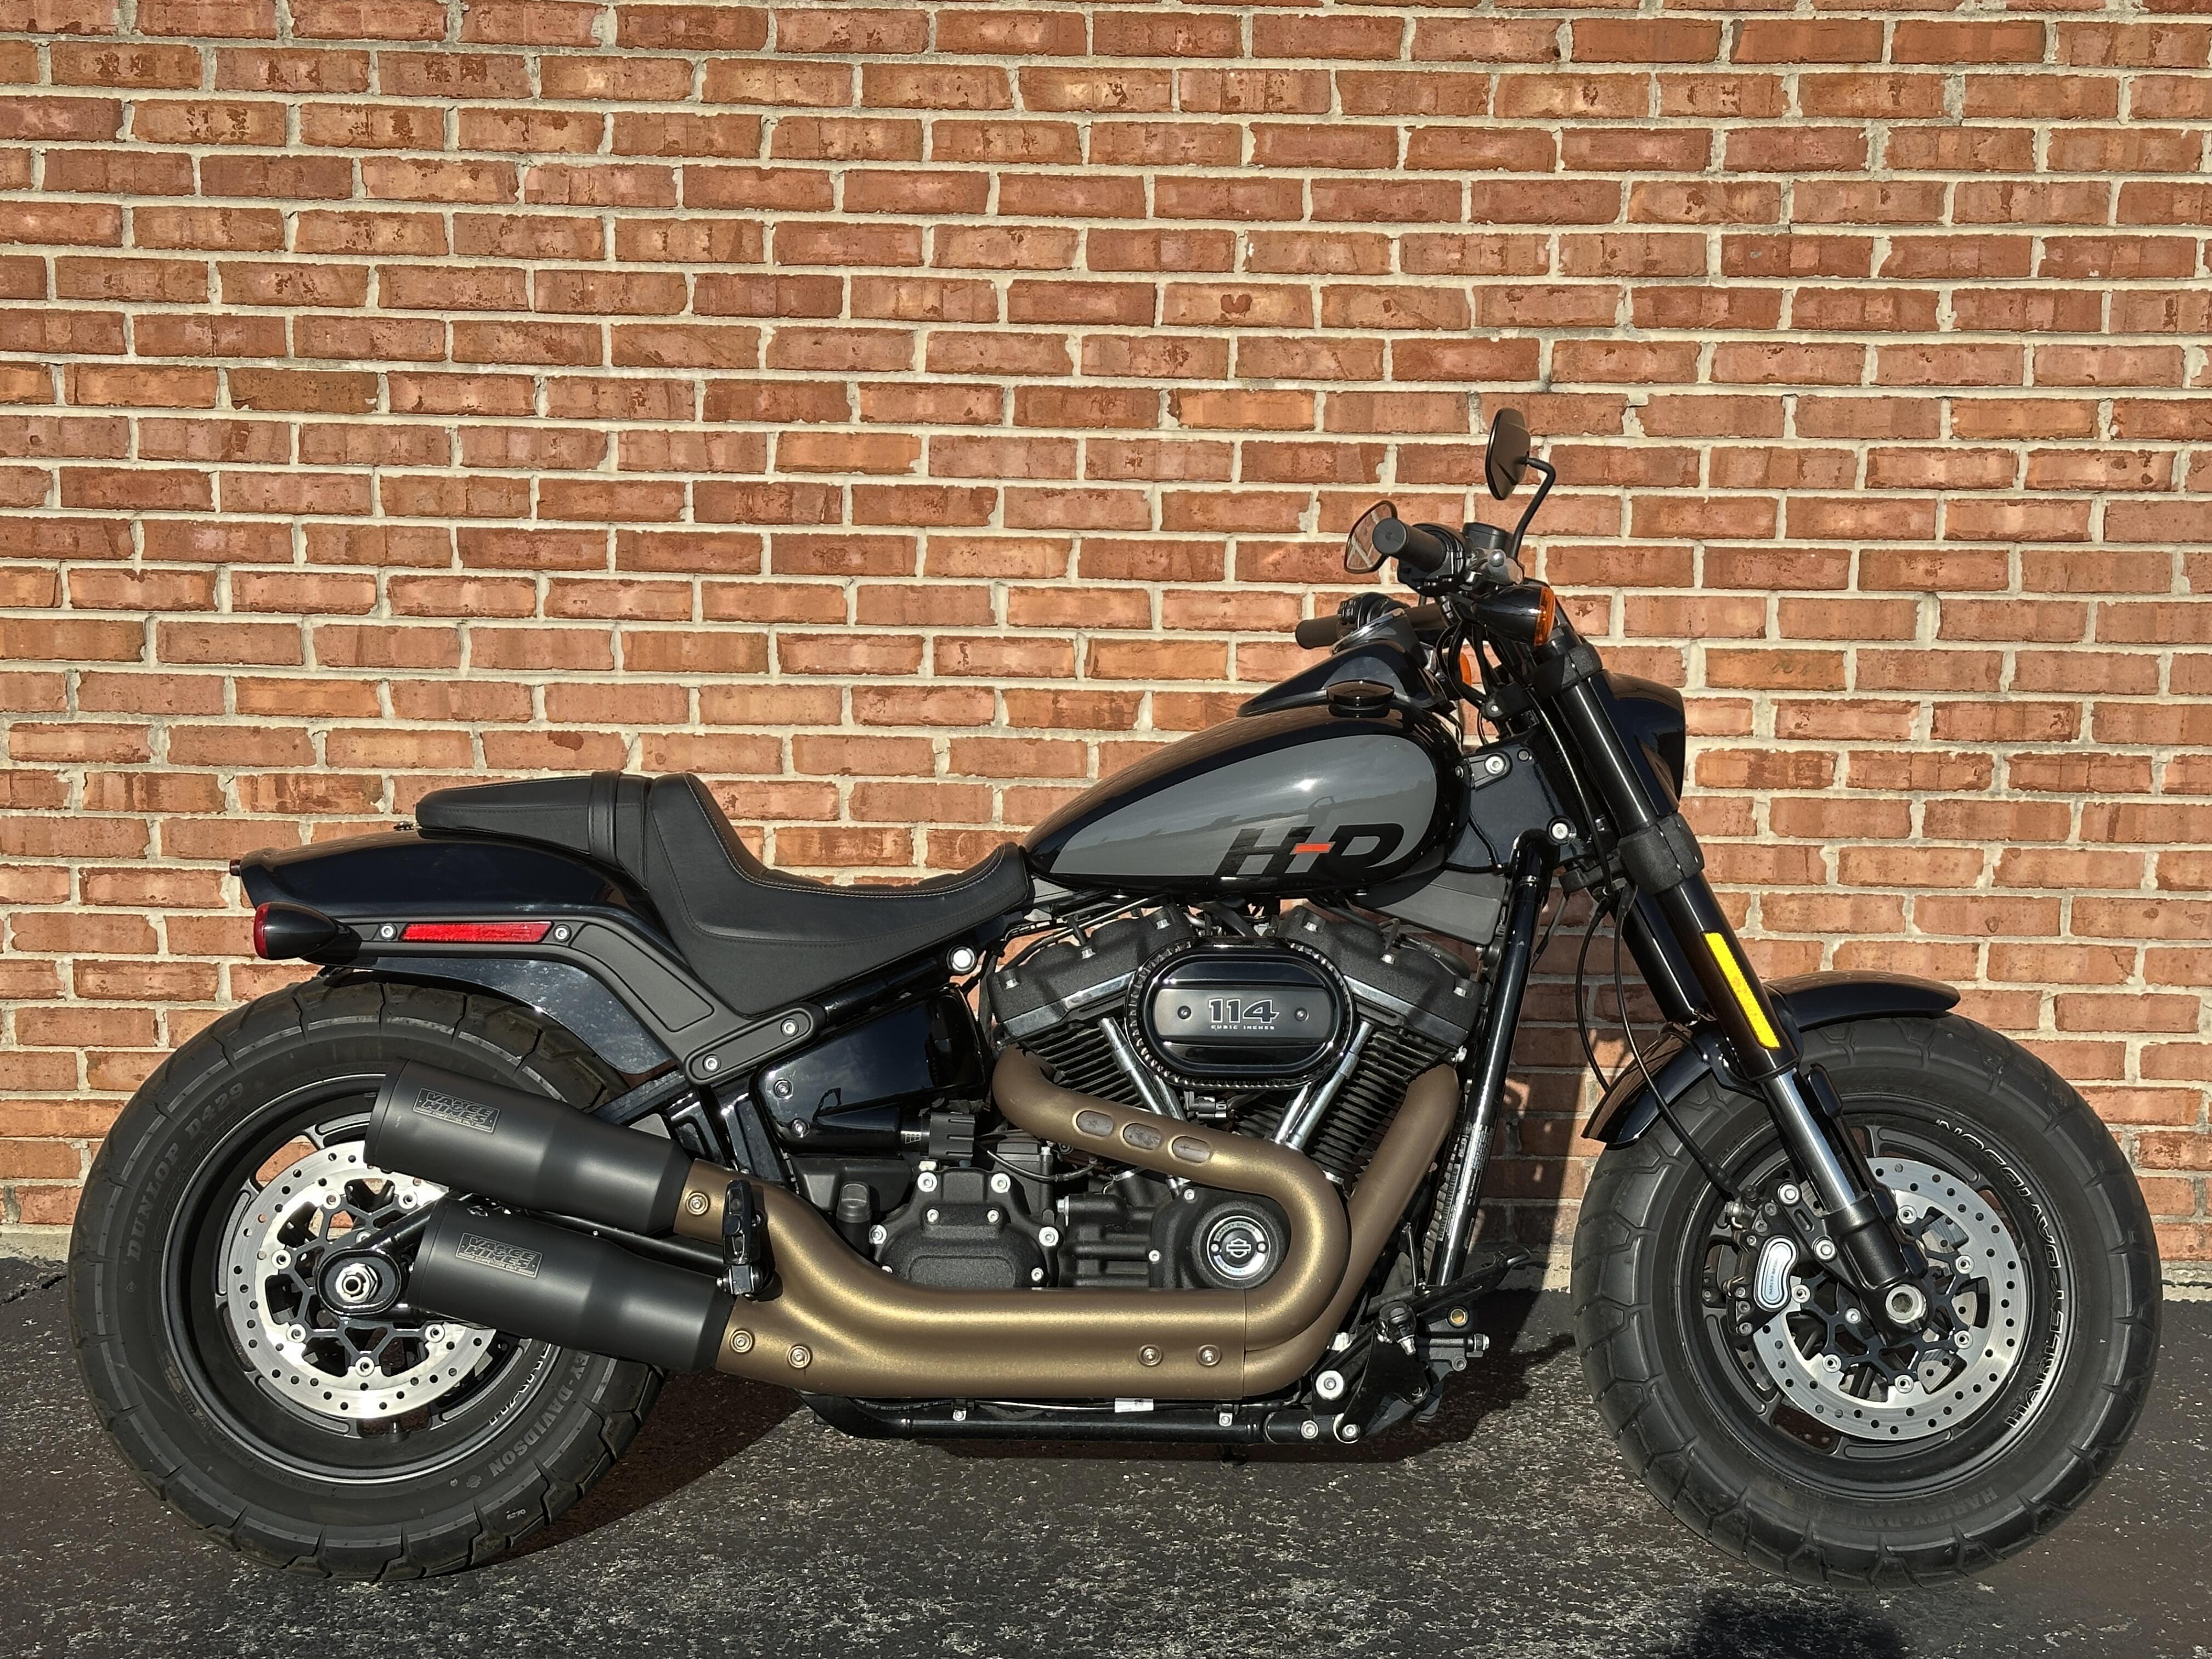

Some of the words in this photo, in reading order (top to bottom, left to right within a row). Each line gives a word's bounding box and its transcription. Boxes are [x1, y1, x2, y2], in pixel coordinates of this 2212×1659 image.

[1212, 822, 1404, 877] H-D
[1209, 998, 1280, 1024] 114
[421, 1100, 487, 1124] HINES
[426, 1092, 494, 1117] VANCE
[127, 1142, 179, 1262] DUNLOP
[185, 1082, 244, 1140] D429
[464, 1245, 530, 1269] HINES
[469, 1237, 537, 1262] VANCE
[1936, 1119, 2065, 1429] HARLEY-DAVIDSON
[488, 1351, 590, 1477] EY-DAVIDSON
